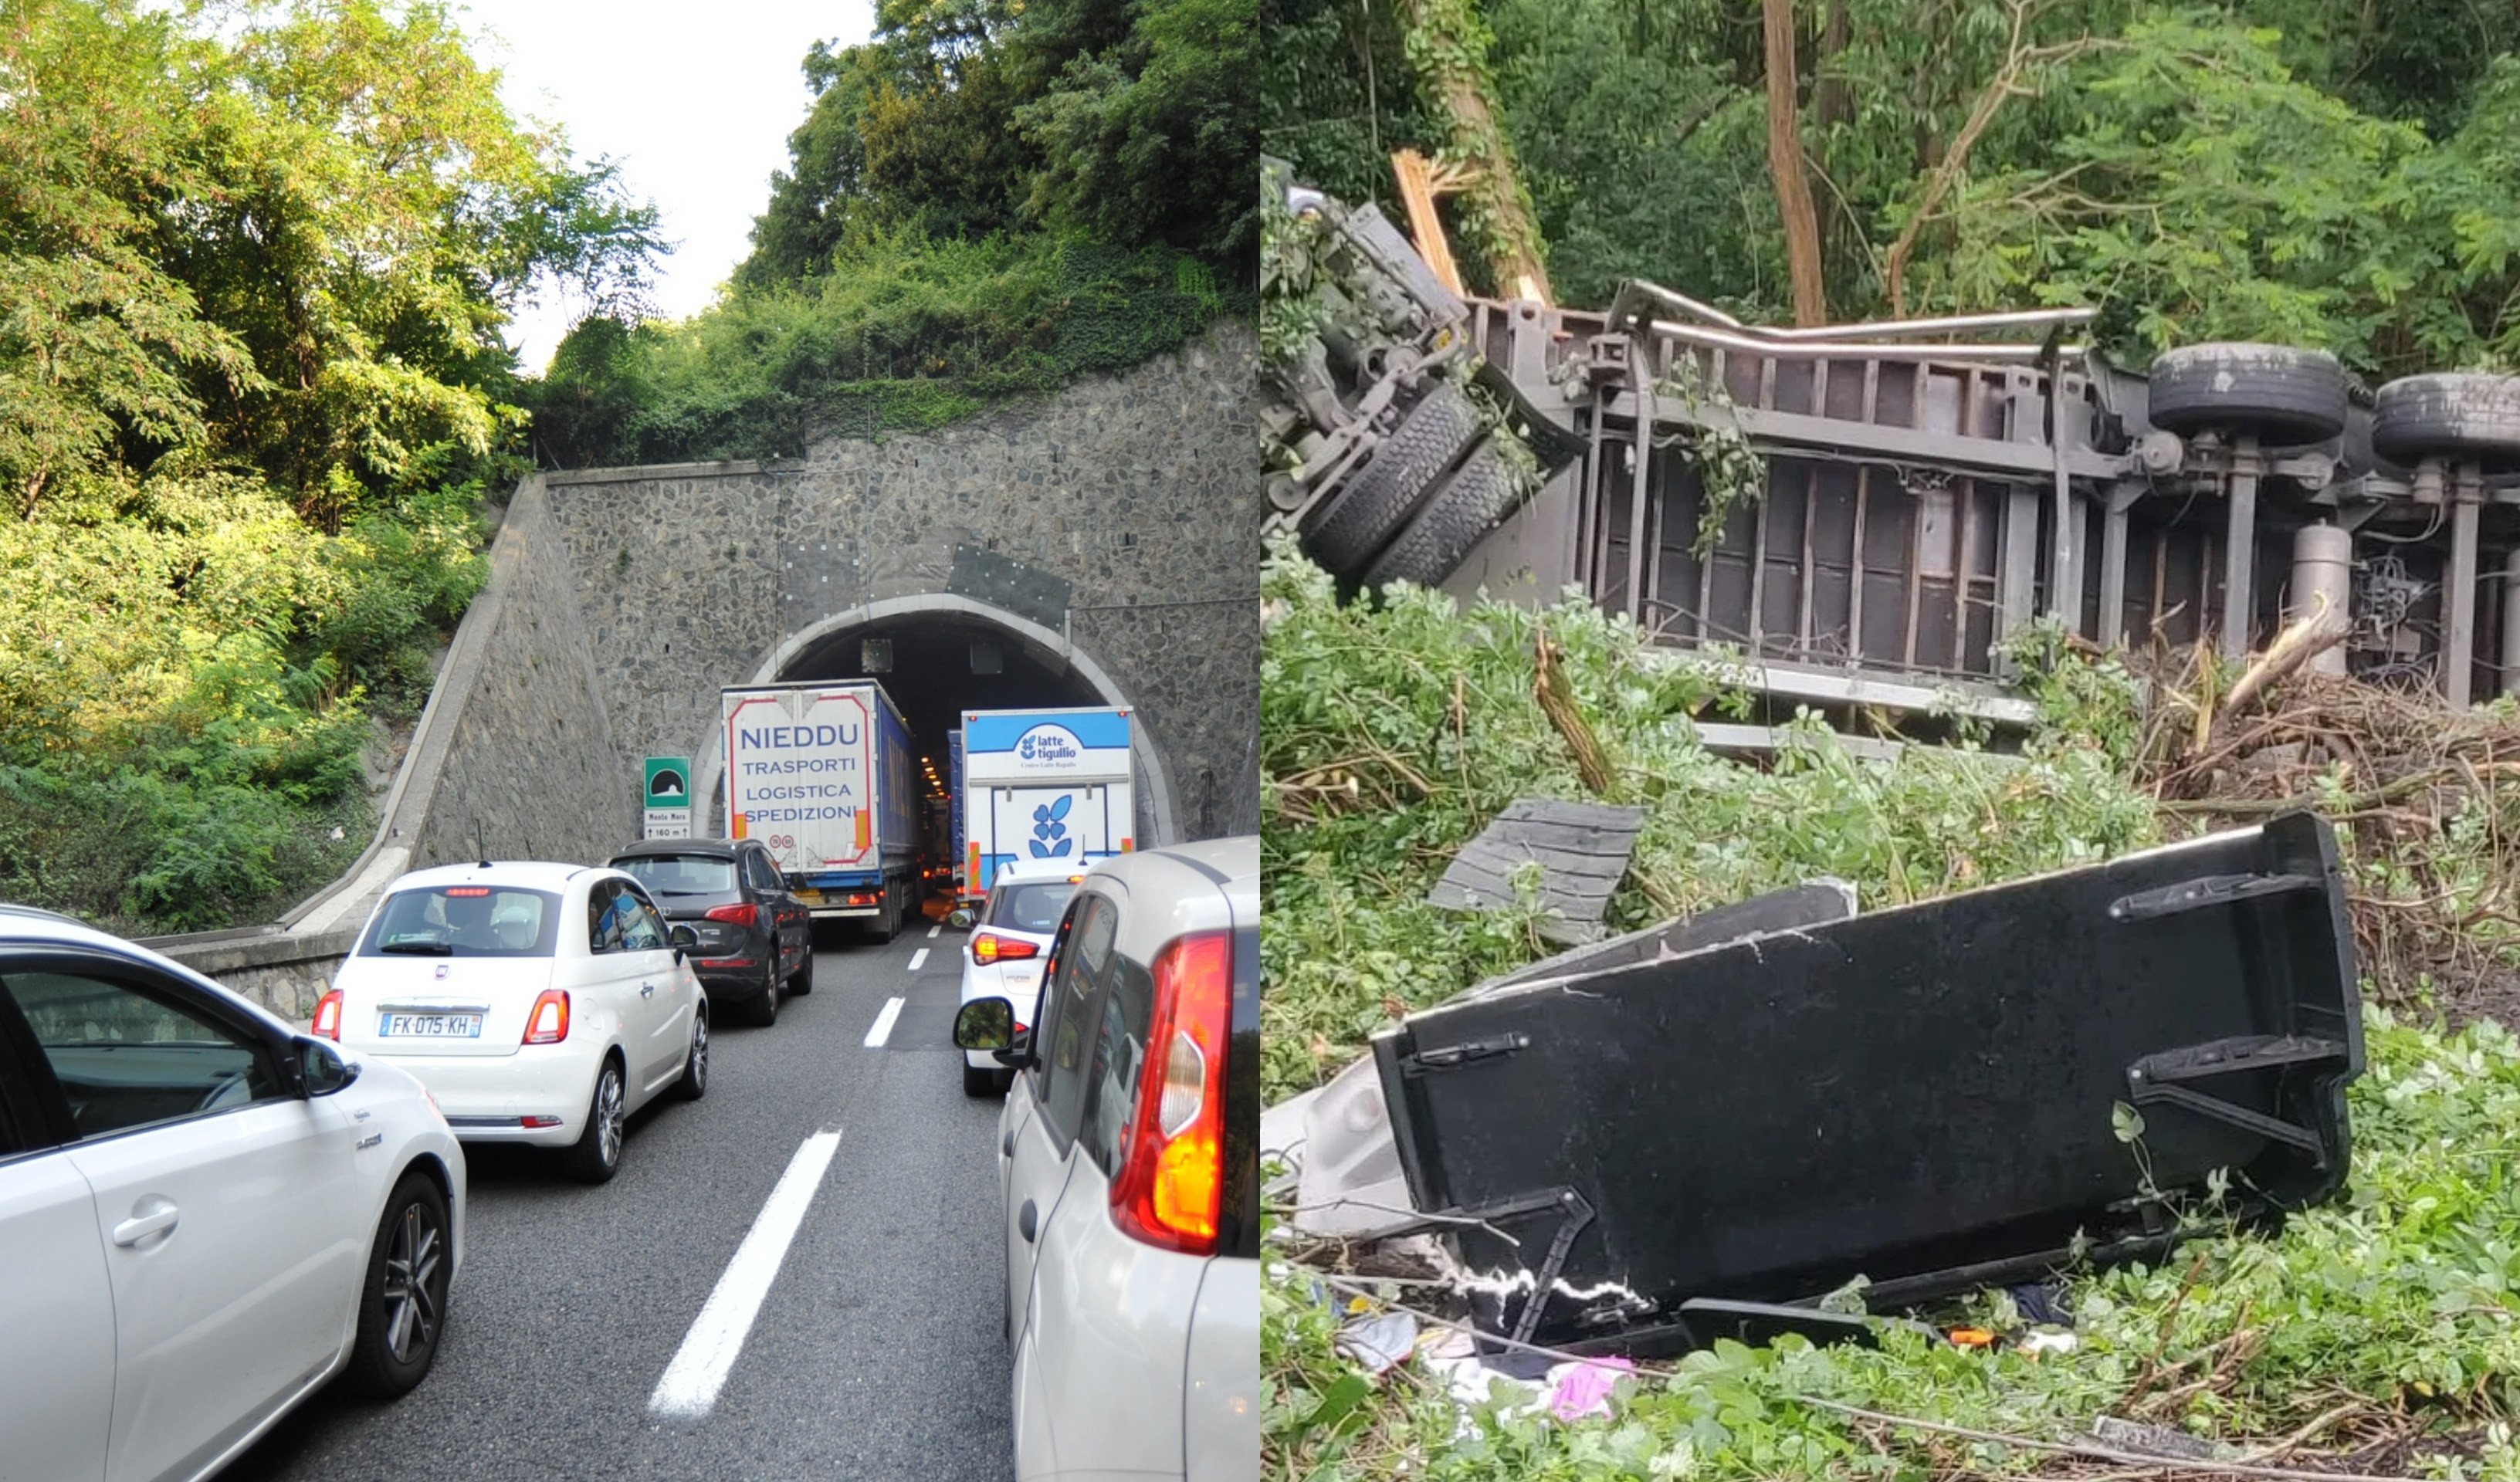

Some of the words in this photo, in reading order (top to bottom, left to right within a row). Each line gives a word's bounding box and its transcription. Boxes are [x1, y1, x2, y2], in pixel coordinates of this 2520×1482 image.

[740, 723, 858, 749] NIEDDU
[1038, 736, 1064, 746] latte
[1038, 746, 1076, 761] tigullio
[742, 757, 855, 776] TRASPORTI
[747, 784, 852, 800] LOGISTICA
[744, 805, 857, 823] SPEDIZIONI
